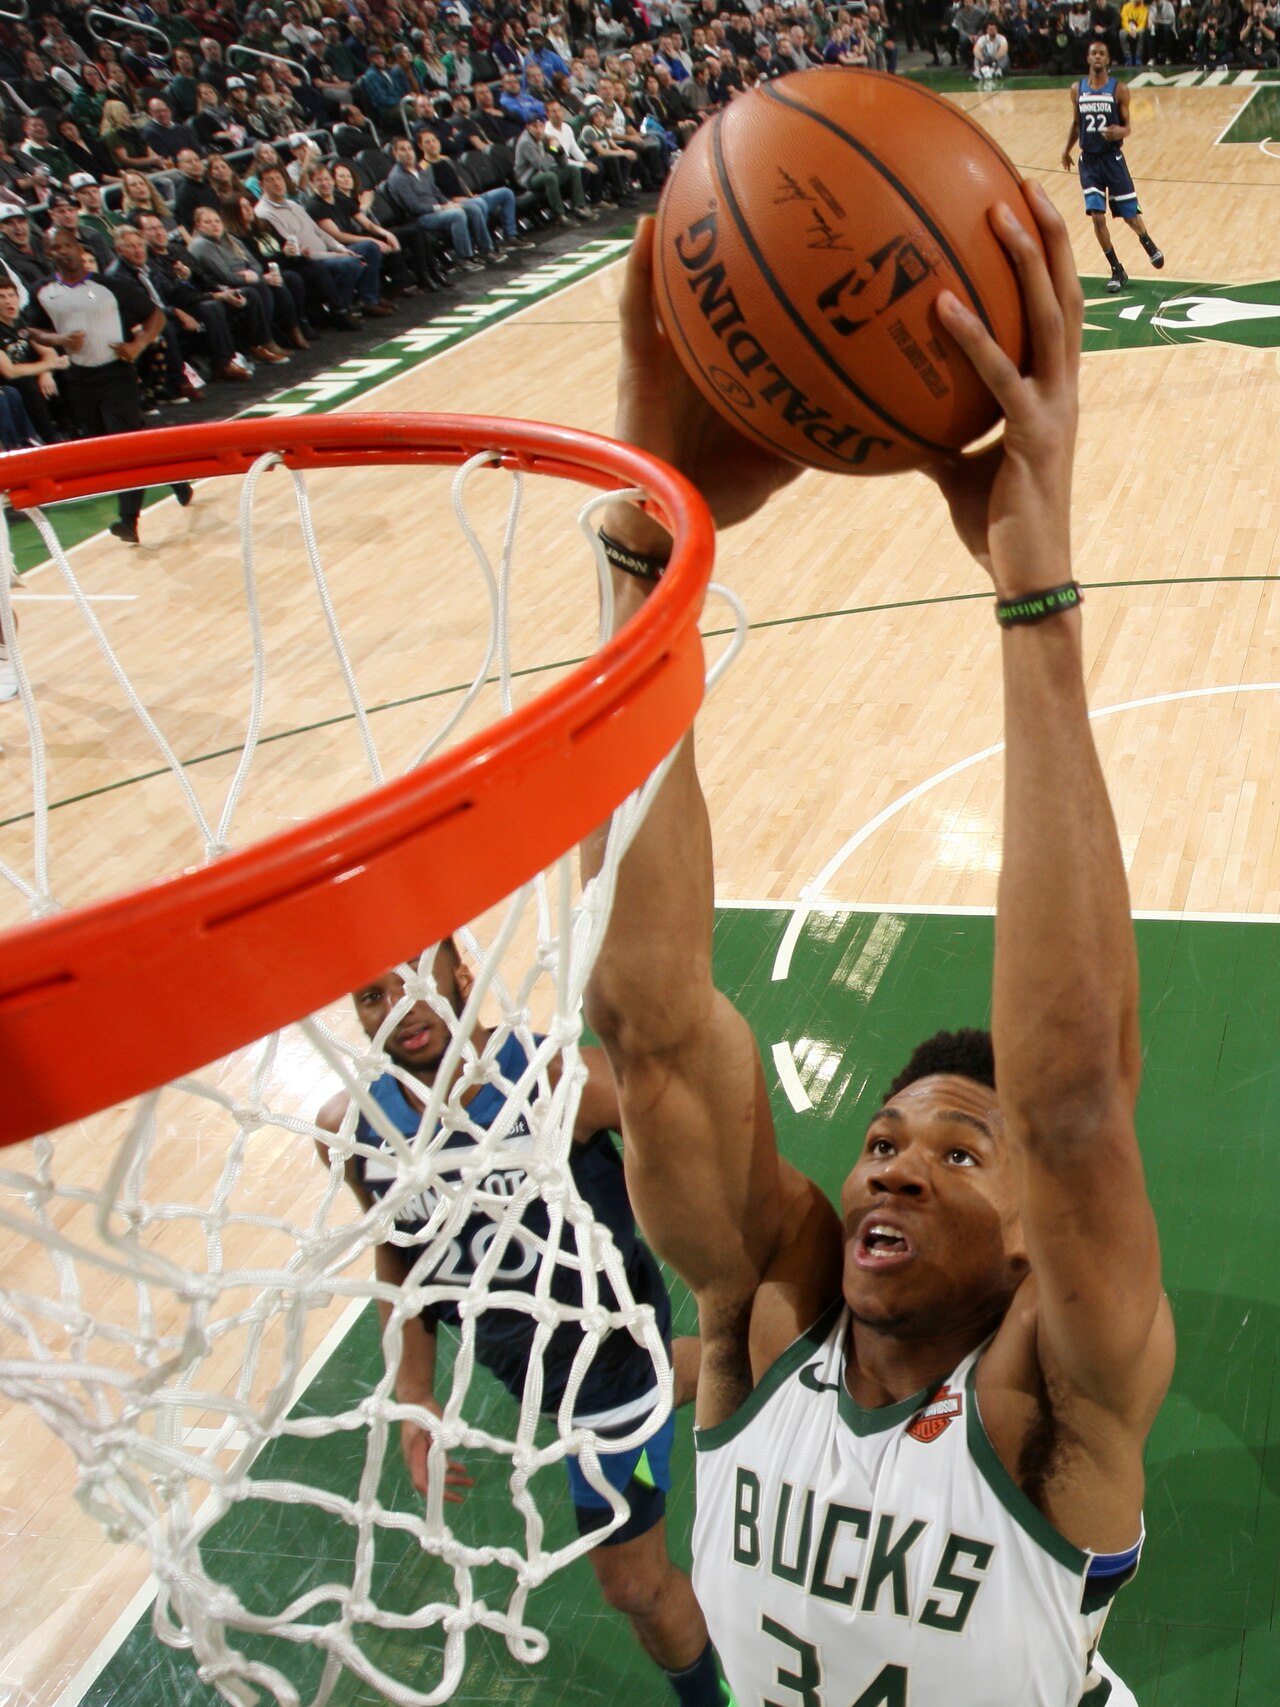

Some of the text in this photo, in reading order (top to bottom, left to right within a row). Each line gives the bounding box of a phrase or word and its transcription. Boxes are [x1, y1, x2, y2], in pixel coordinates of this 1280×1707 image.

[1079, 102, 1112, 113] MINNESOTA
[1085, 114, 1109, 132] 22
[674, 212, 895, 465] SPALDING
[606, 547, 648, 573] Never
[1045, 595, 1056, 607] a
[1057, 588, 1077, 603] On
[732, 1463, 999, 1633] BUCKS
